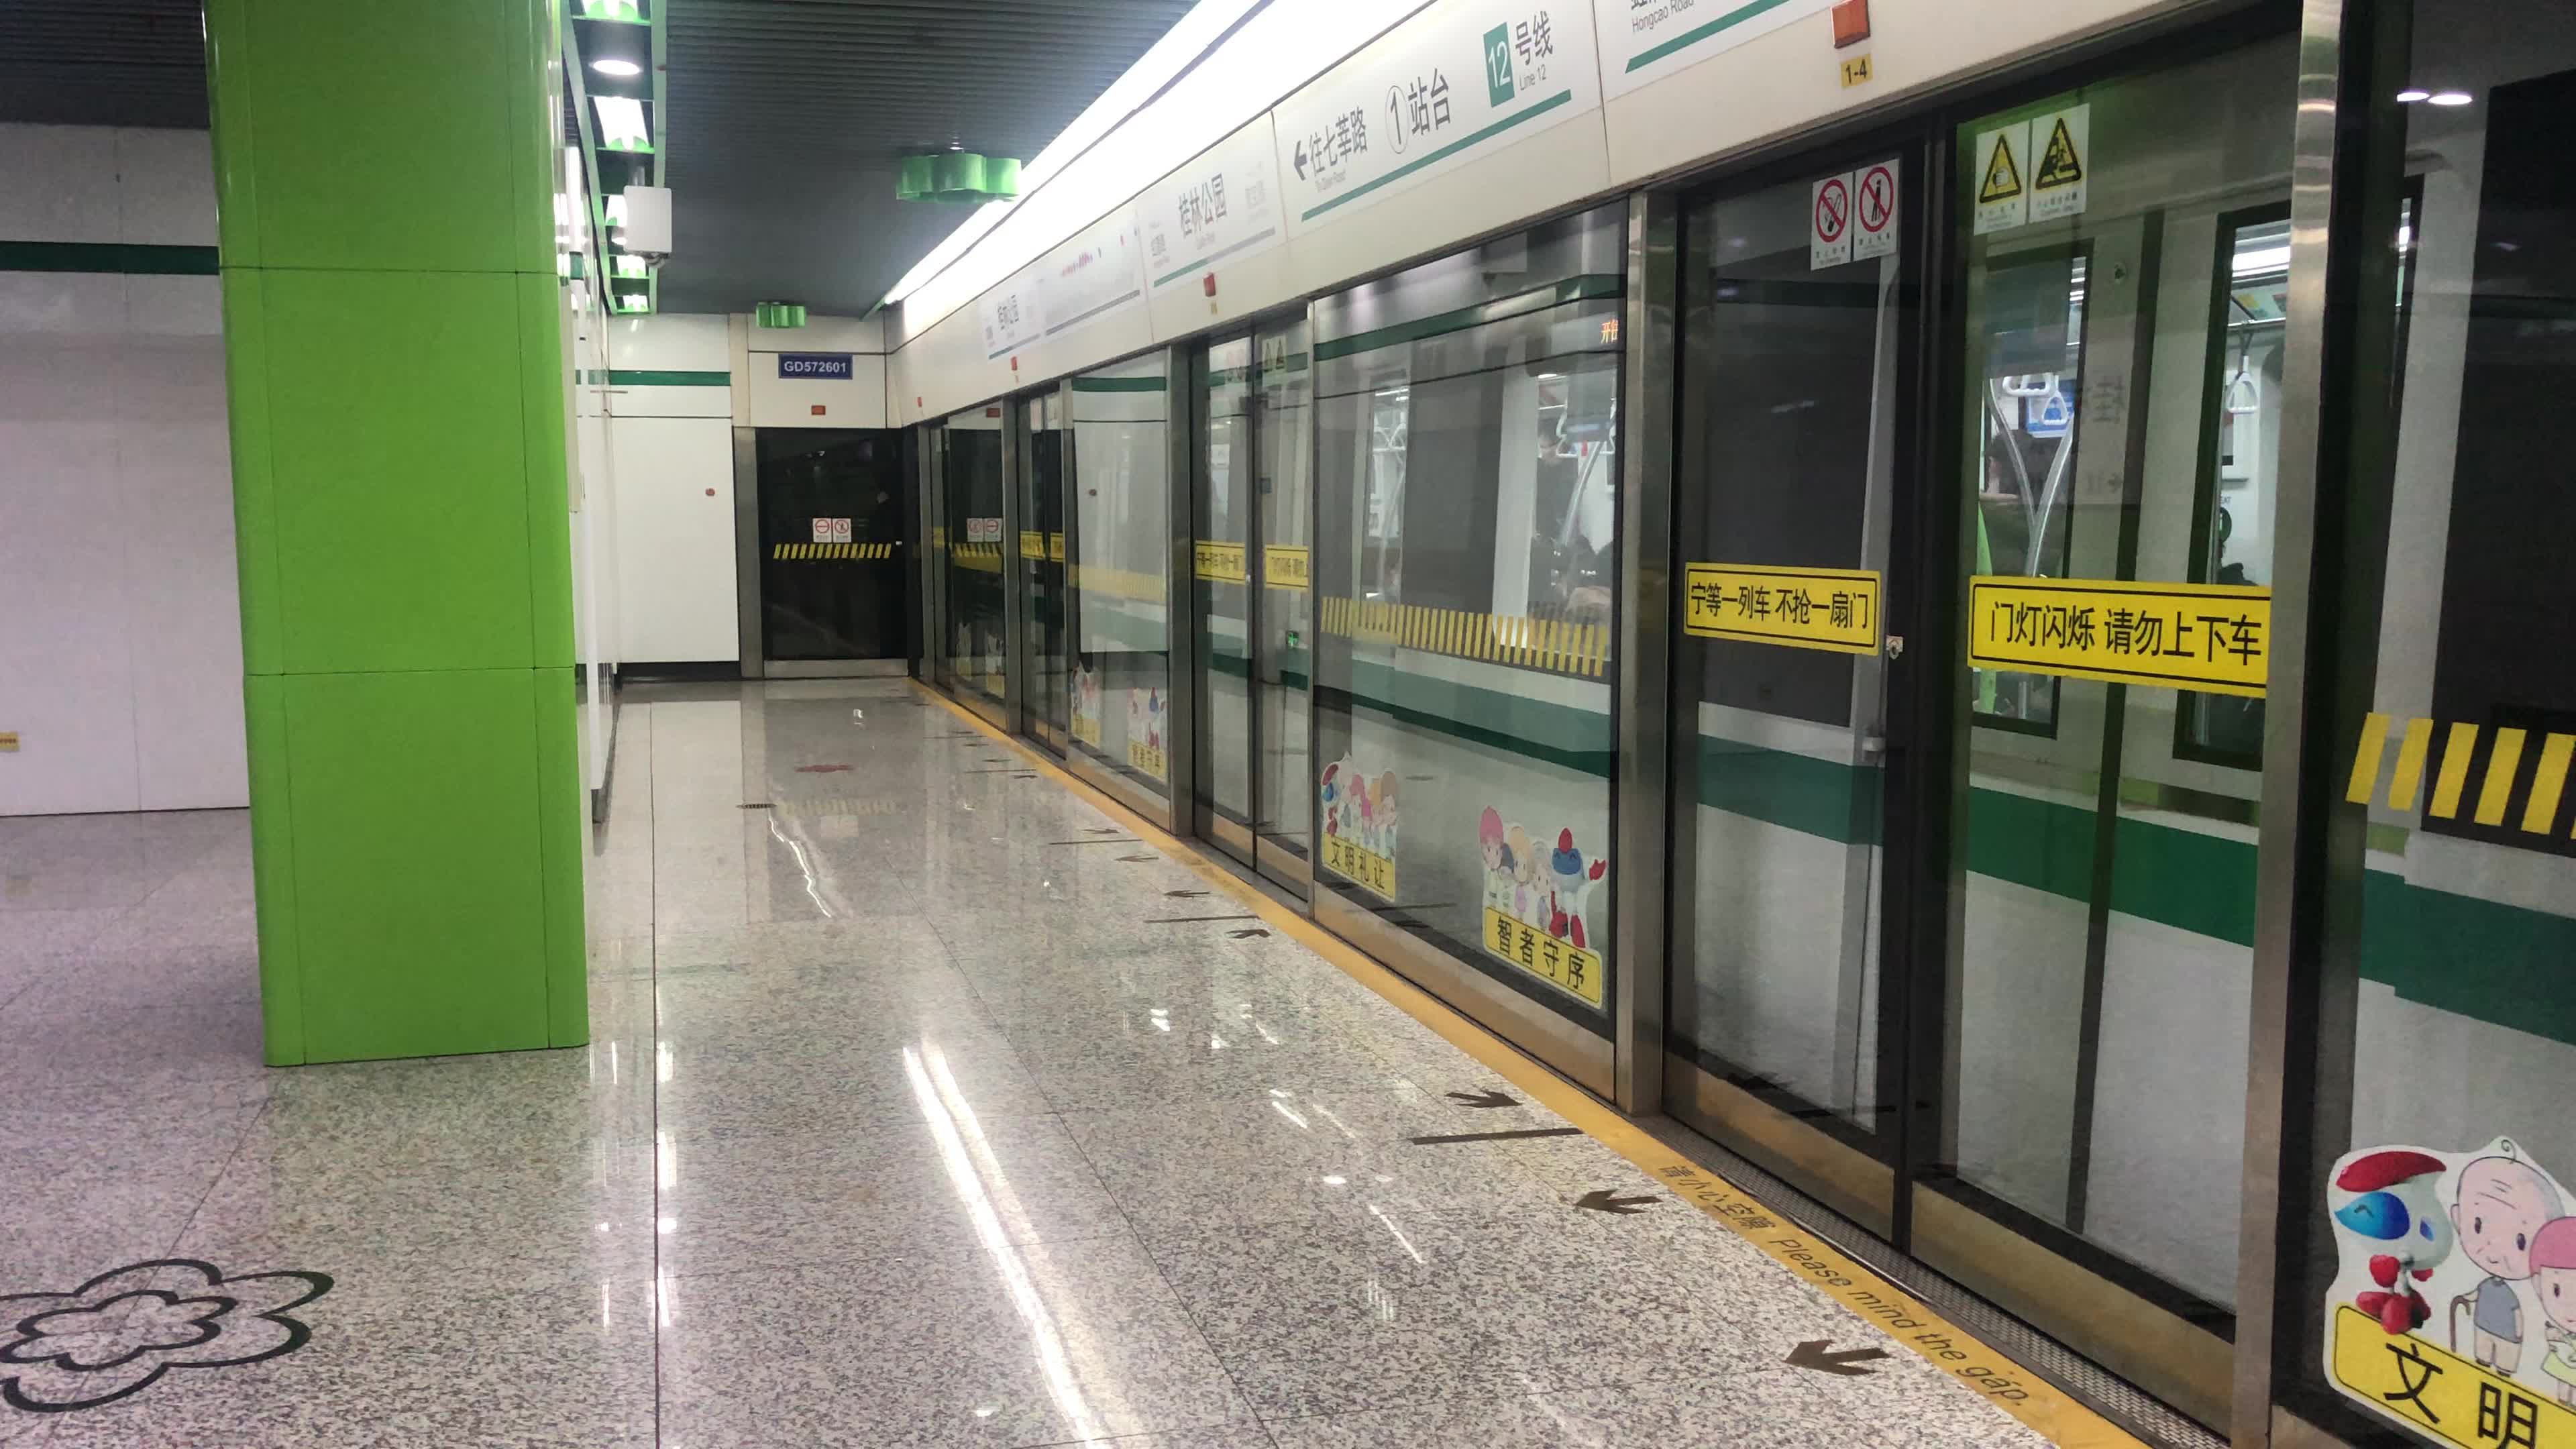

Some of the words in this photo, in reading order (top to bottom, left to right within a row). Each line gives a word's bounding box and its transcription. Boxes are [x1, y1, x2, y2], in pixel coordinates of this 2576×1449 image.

[1489, 41, 1511, 88] 12
[1515, 11, 1553, 65] 号线
[1631, 6, 1668, 33] Hongcao
[1519, 72, 1536, 91] Line
[1536, 64, 1546, 80] 12
[1846, 58, 1867, 84] 1-4
[1309, 105, 1368, 176] 往七莘路
[1179, 172, 1228, 239] 桂林公园
[784, 361, 847, 372] GD572601
[1690, 581, 1771, 619] 宁等一列车
[1775, 586, 1869, 630] 不抢一扇门
[1990, 600, 2096, 652] 门灯闪烁
[2104, 606, 2262, 666] 请勿上下车
[1331, 840, 1385, 890] 文明礼让
[1497, 915, 1585, 989] 智者守序
[1770, 1238, 1852, 1287] Please
[1848, 1291, 1919, 1330] mind
[1913, 1332, 1968, 1362] the
[2383, 1342, 2538, 1449] 文明
